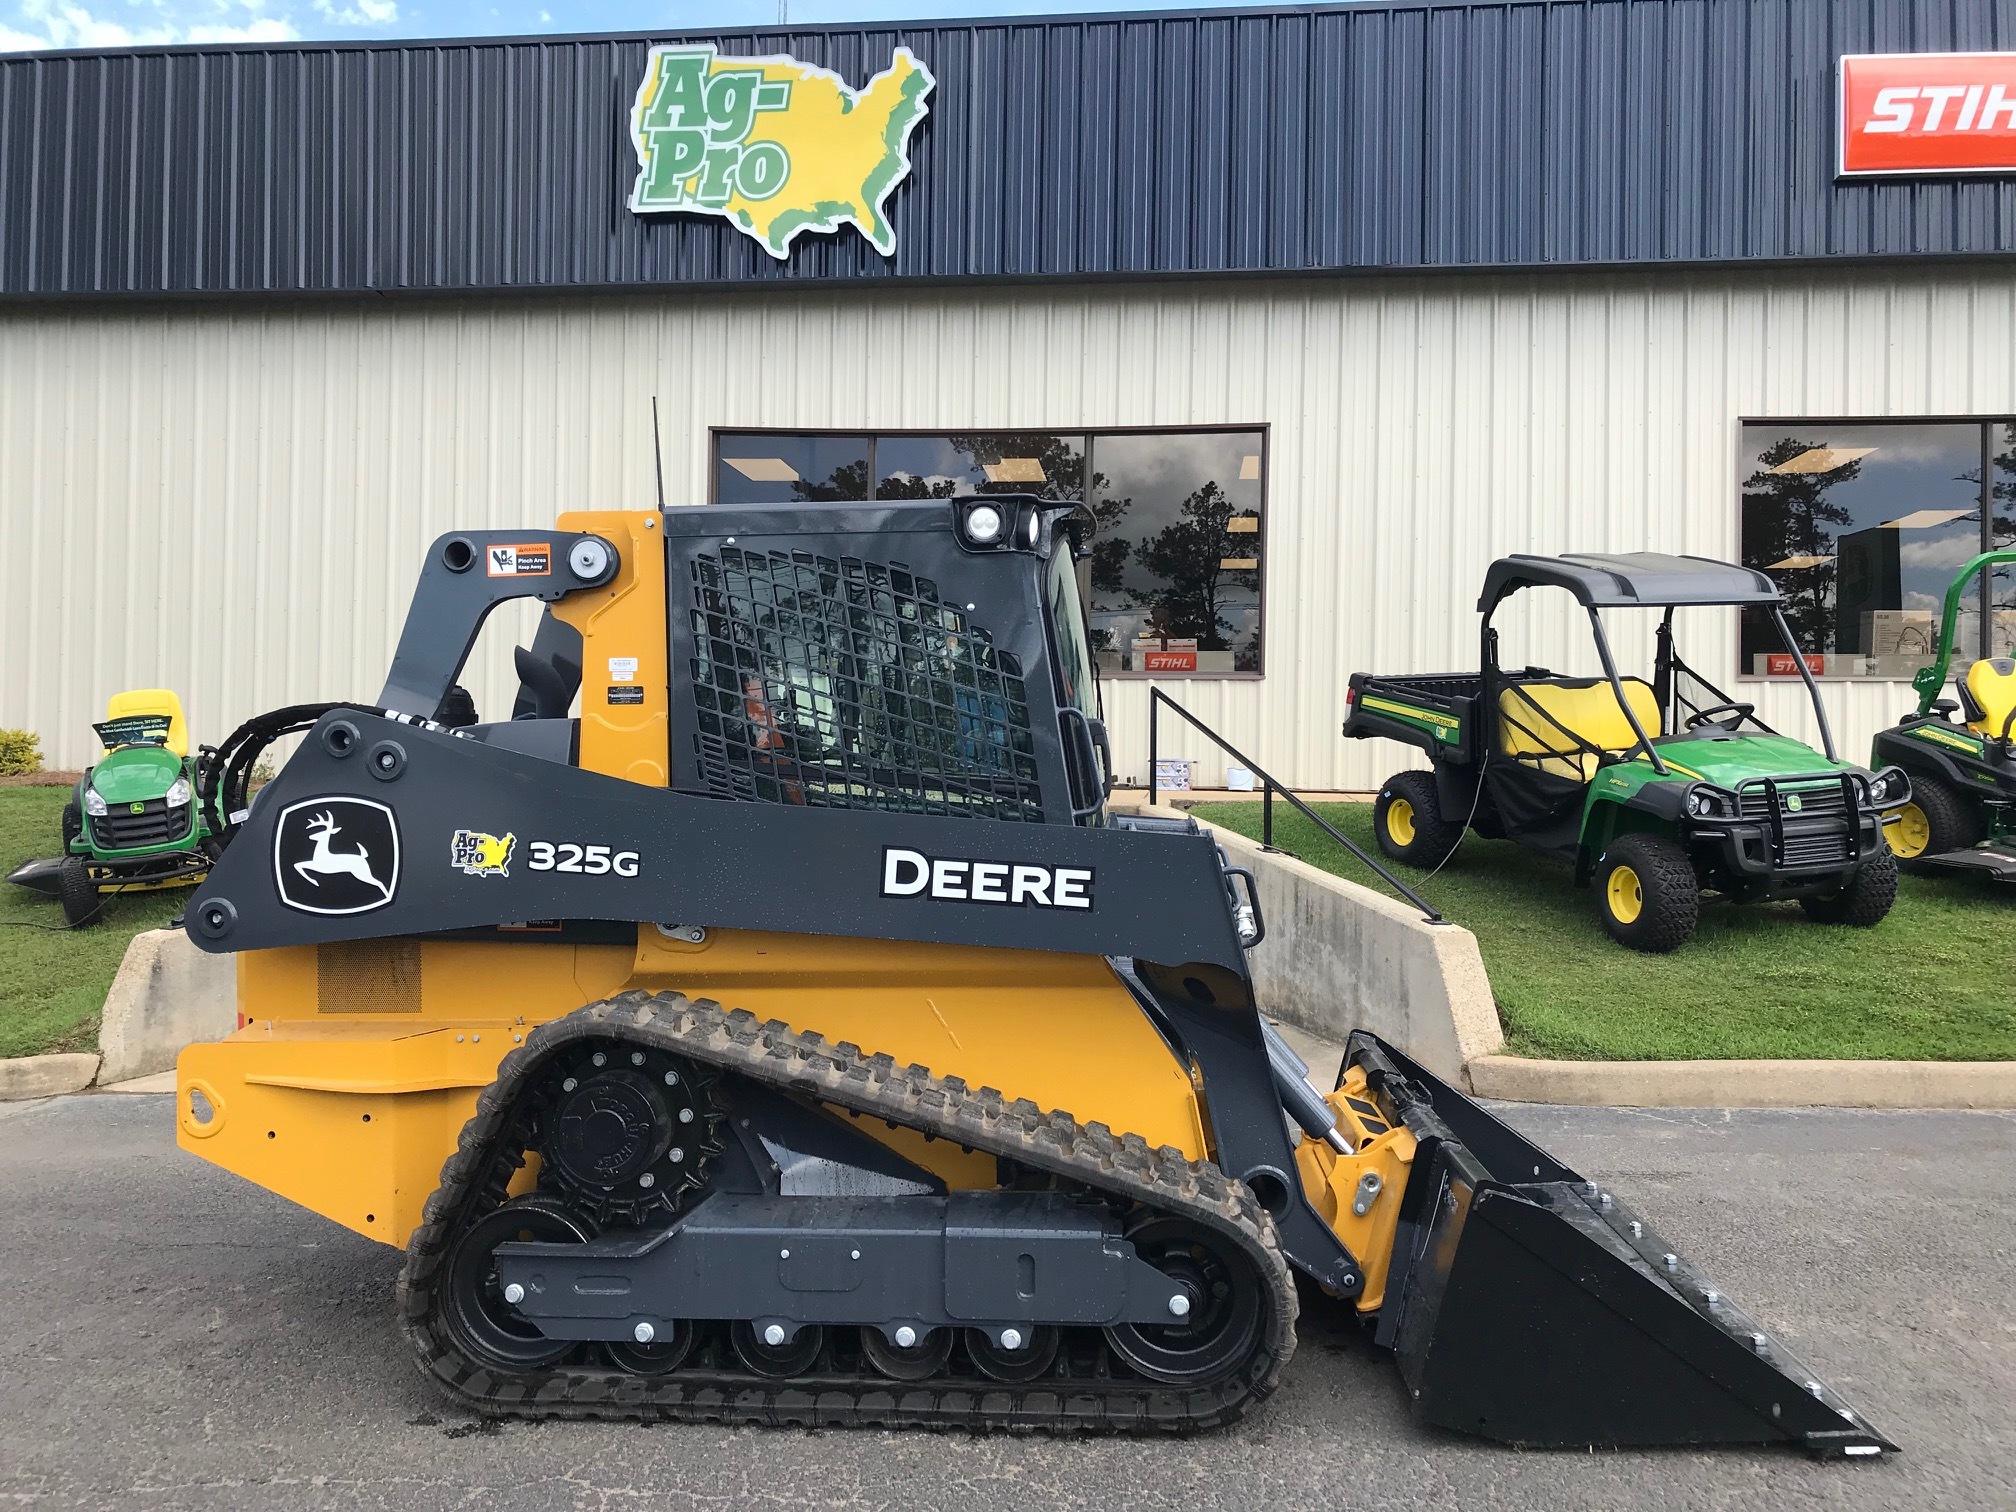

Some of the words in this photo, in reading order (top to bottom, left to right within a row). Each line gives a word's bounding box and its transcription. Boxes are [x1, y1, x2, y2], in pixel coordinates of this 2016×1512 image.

[642, 54, 790, 145] Ag-
[641, 130, 789, 203] Pro
[1149, 658, 1191, 668] STIHL
[1773, 660, 1820, 672] STIL
[1421, 713, 1435, 722] JOHN
[1435, 716, 1453, 726] DEERE
[455, 832, 485, 851] Ag-
[455, 848, 485, 863] Pro
[528, 841, 640, 877] 325G
[884, 849, 1092, 908] DEERE
